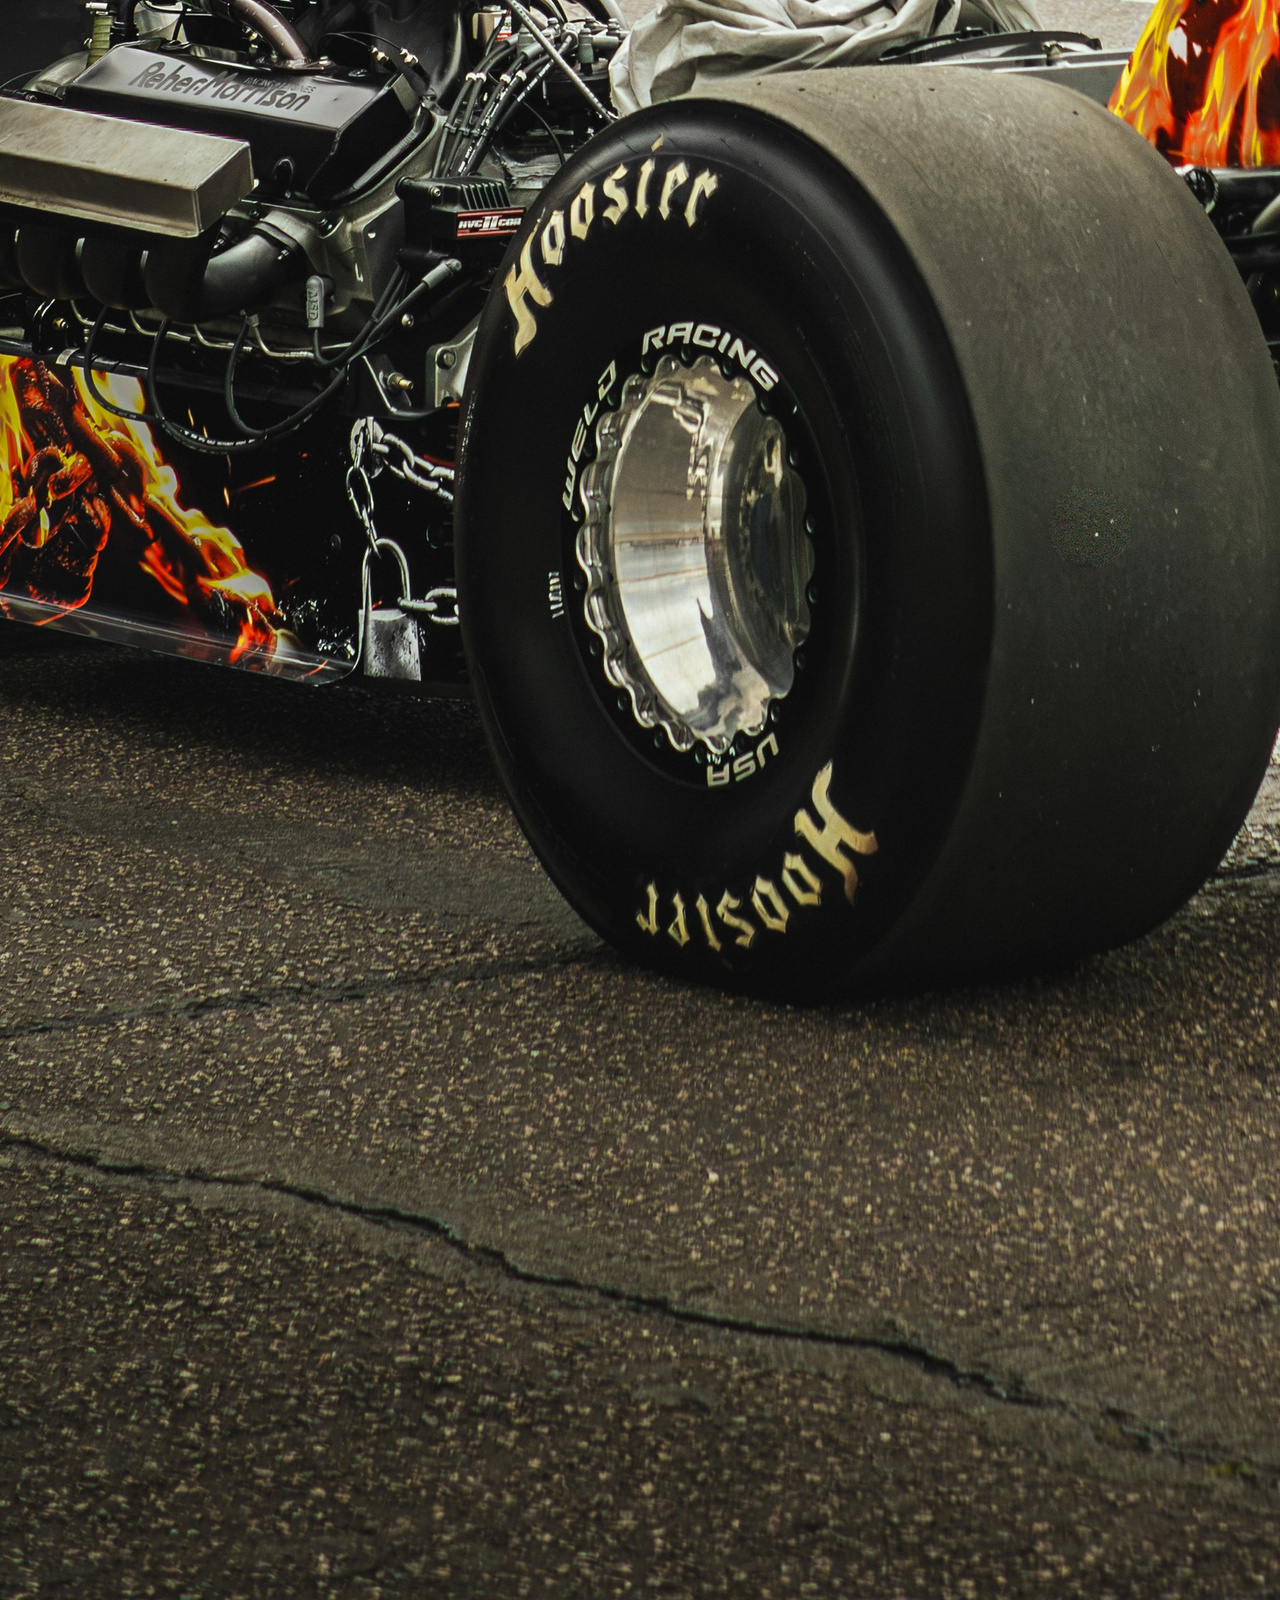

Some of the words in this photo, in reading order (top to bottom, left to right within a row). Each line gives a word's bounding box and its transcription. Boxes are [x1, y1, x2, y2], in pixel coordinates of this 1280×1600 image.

[127, 61, 312, 112] Reher-Morrison
[458, 220, 483, 229] HVC
[502, 133, 718, 358] Hoosier
[562, 359, 617, 511] WELD
[641, 321, 779, 392] RACING
[706, 732, 779, 787] USA
[636, 758, 879, 952] Hoosier
